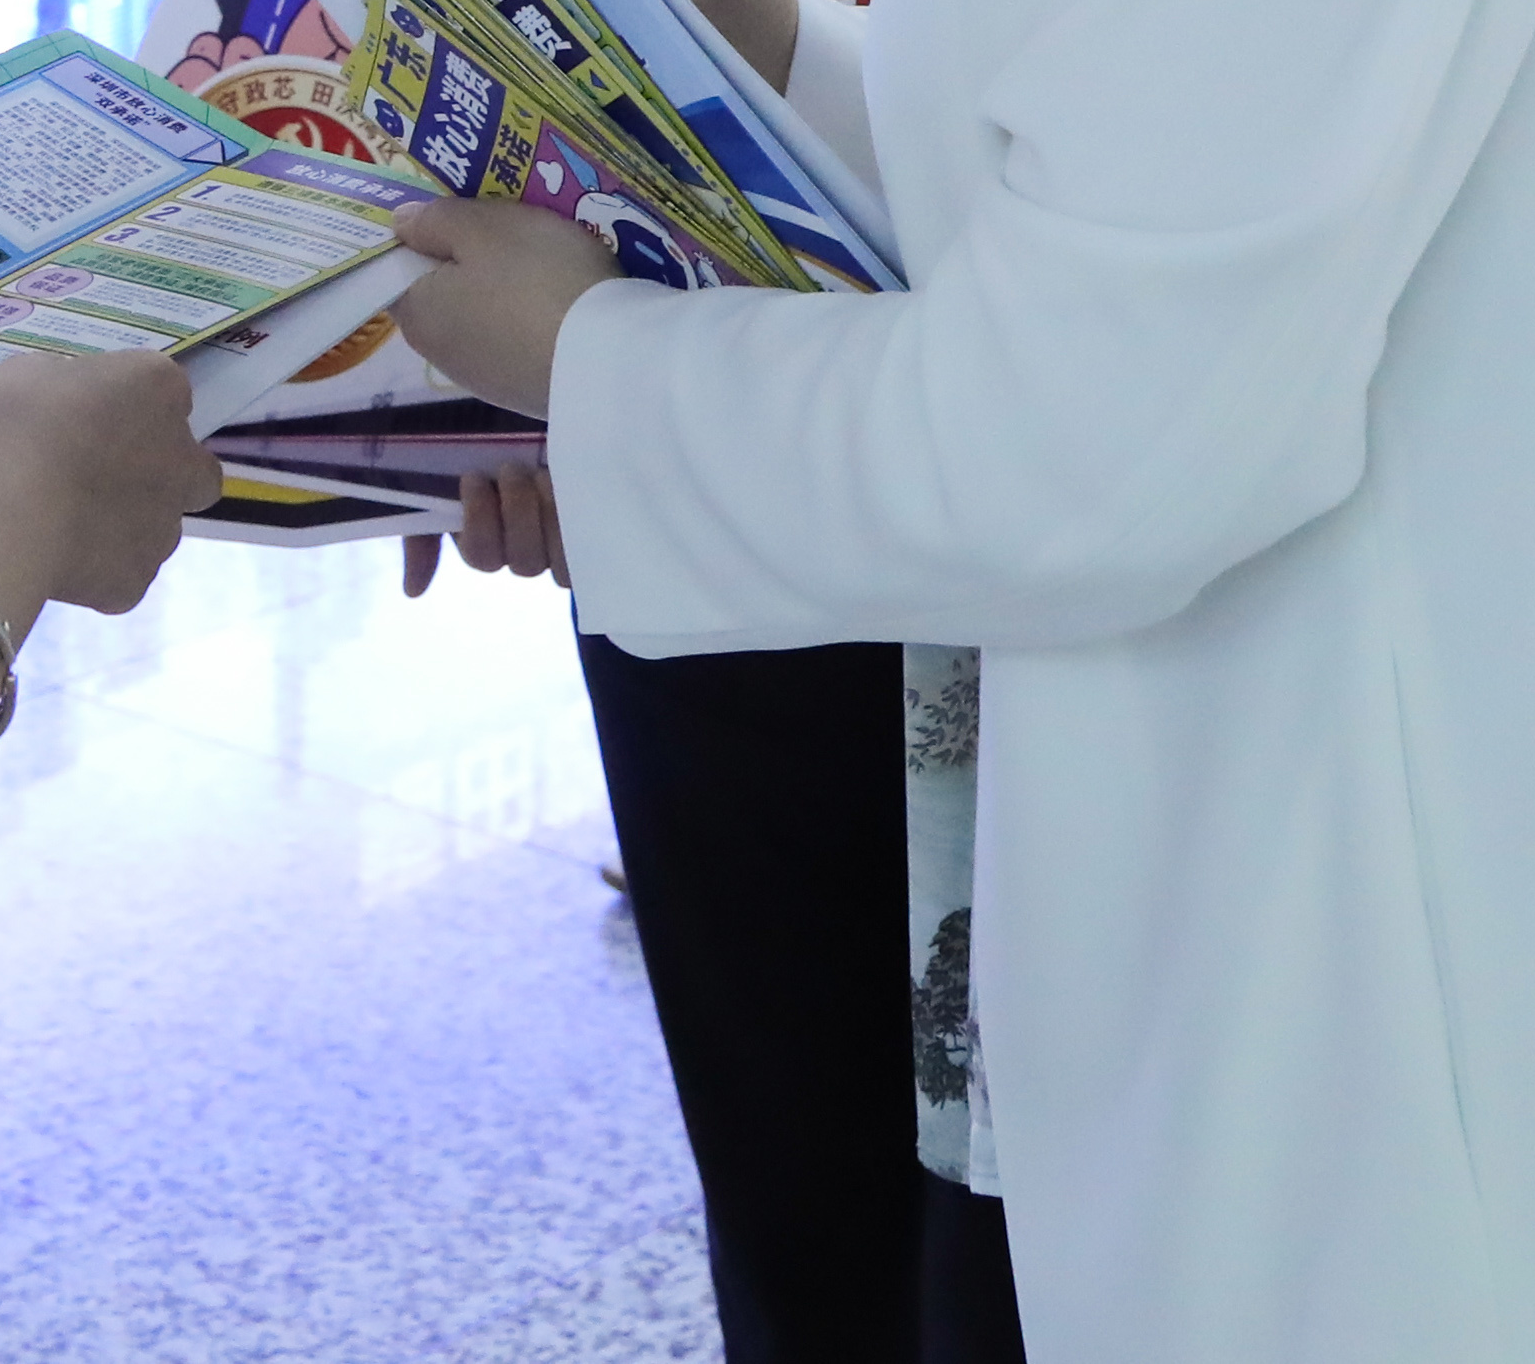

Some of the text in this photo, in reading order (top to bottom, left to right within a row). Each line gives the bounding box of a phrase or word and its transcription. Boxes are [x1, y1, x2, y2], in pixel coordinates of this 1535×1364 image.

[83, 71, 189, 135] 深圳市放心消费
[377, 31, 427, 113] 广东
[422, 50, 494, 190] 放心消费
[285, 163, 405, 203] 放心消费承诺
[490, 123, 533, 195] 承诺
